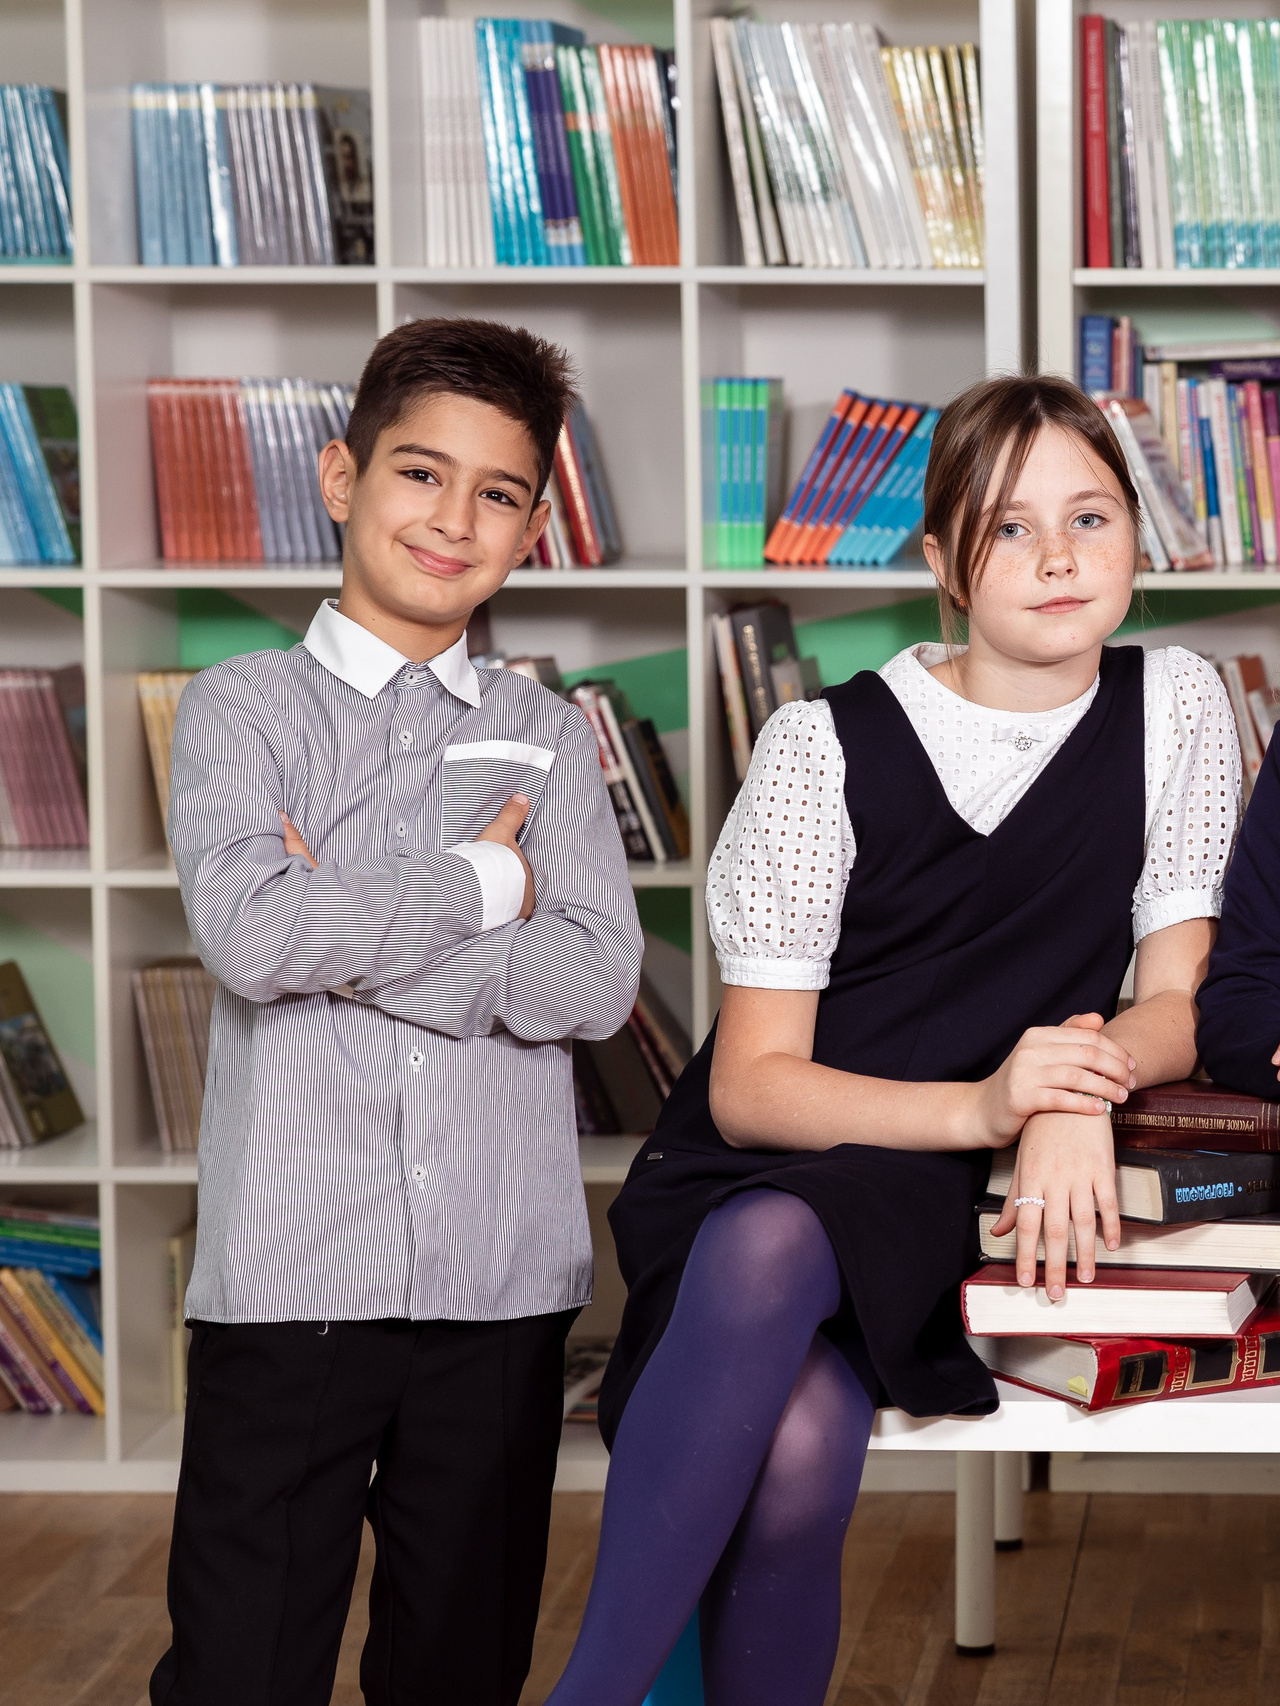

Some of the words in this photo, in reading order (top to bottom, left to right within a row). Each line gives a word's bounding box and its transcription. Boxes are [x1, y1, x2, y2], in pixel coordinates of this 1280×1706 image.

[1123, 1113, 1176, 1127] ПРОИЗНОШЕНИЕ
[1177, 1116, 1226, 1131] ЛИТЕРАТУРНОЕ
[1226, 1118, 1255, 1132] РУССКОЕ
[1174, 1182, 1235, 1204] ГЕОГРАФИЯ
